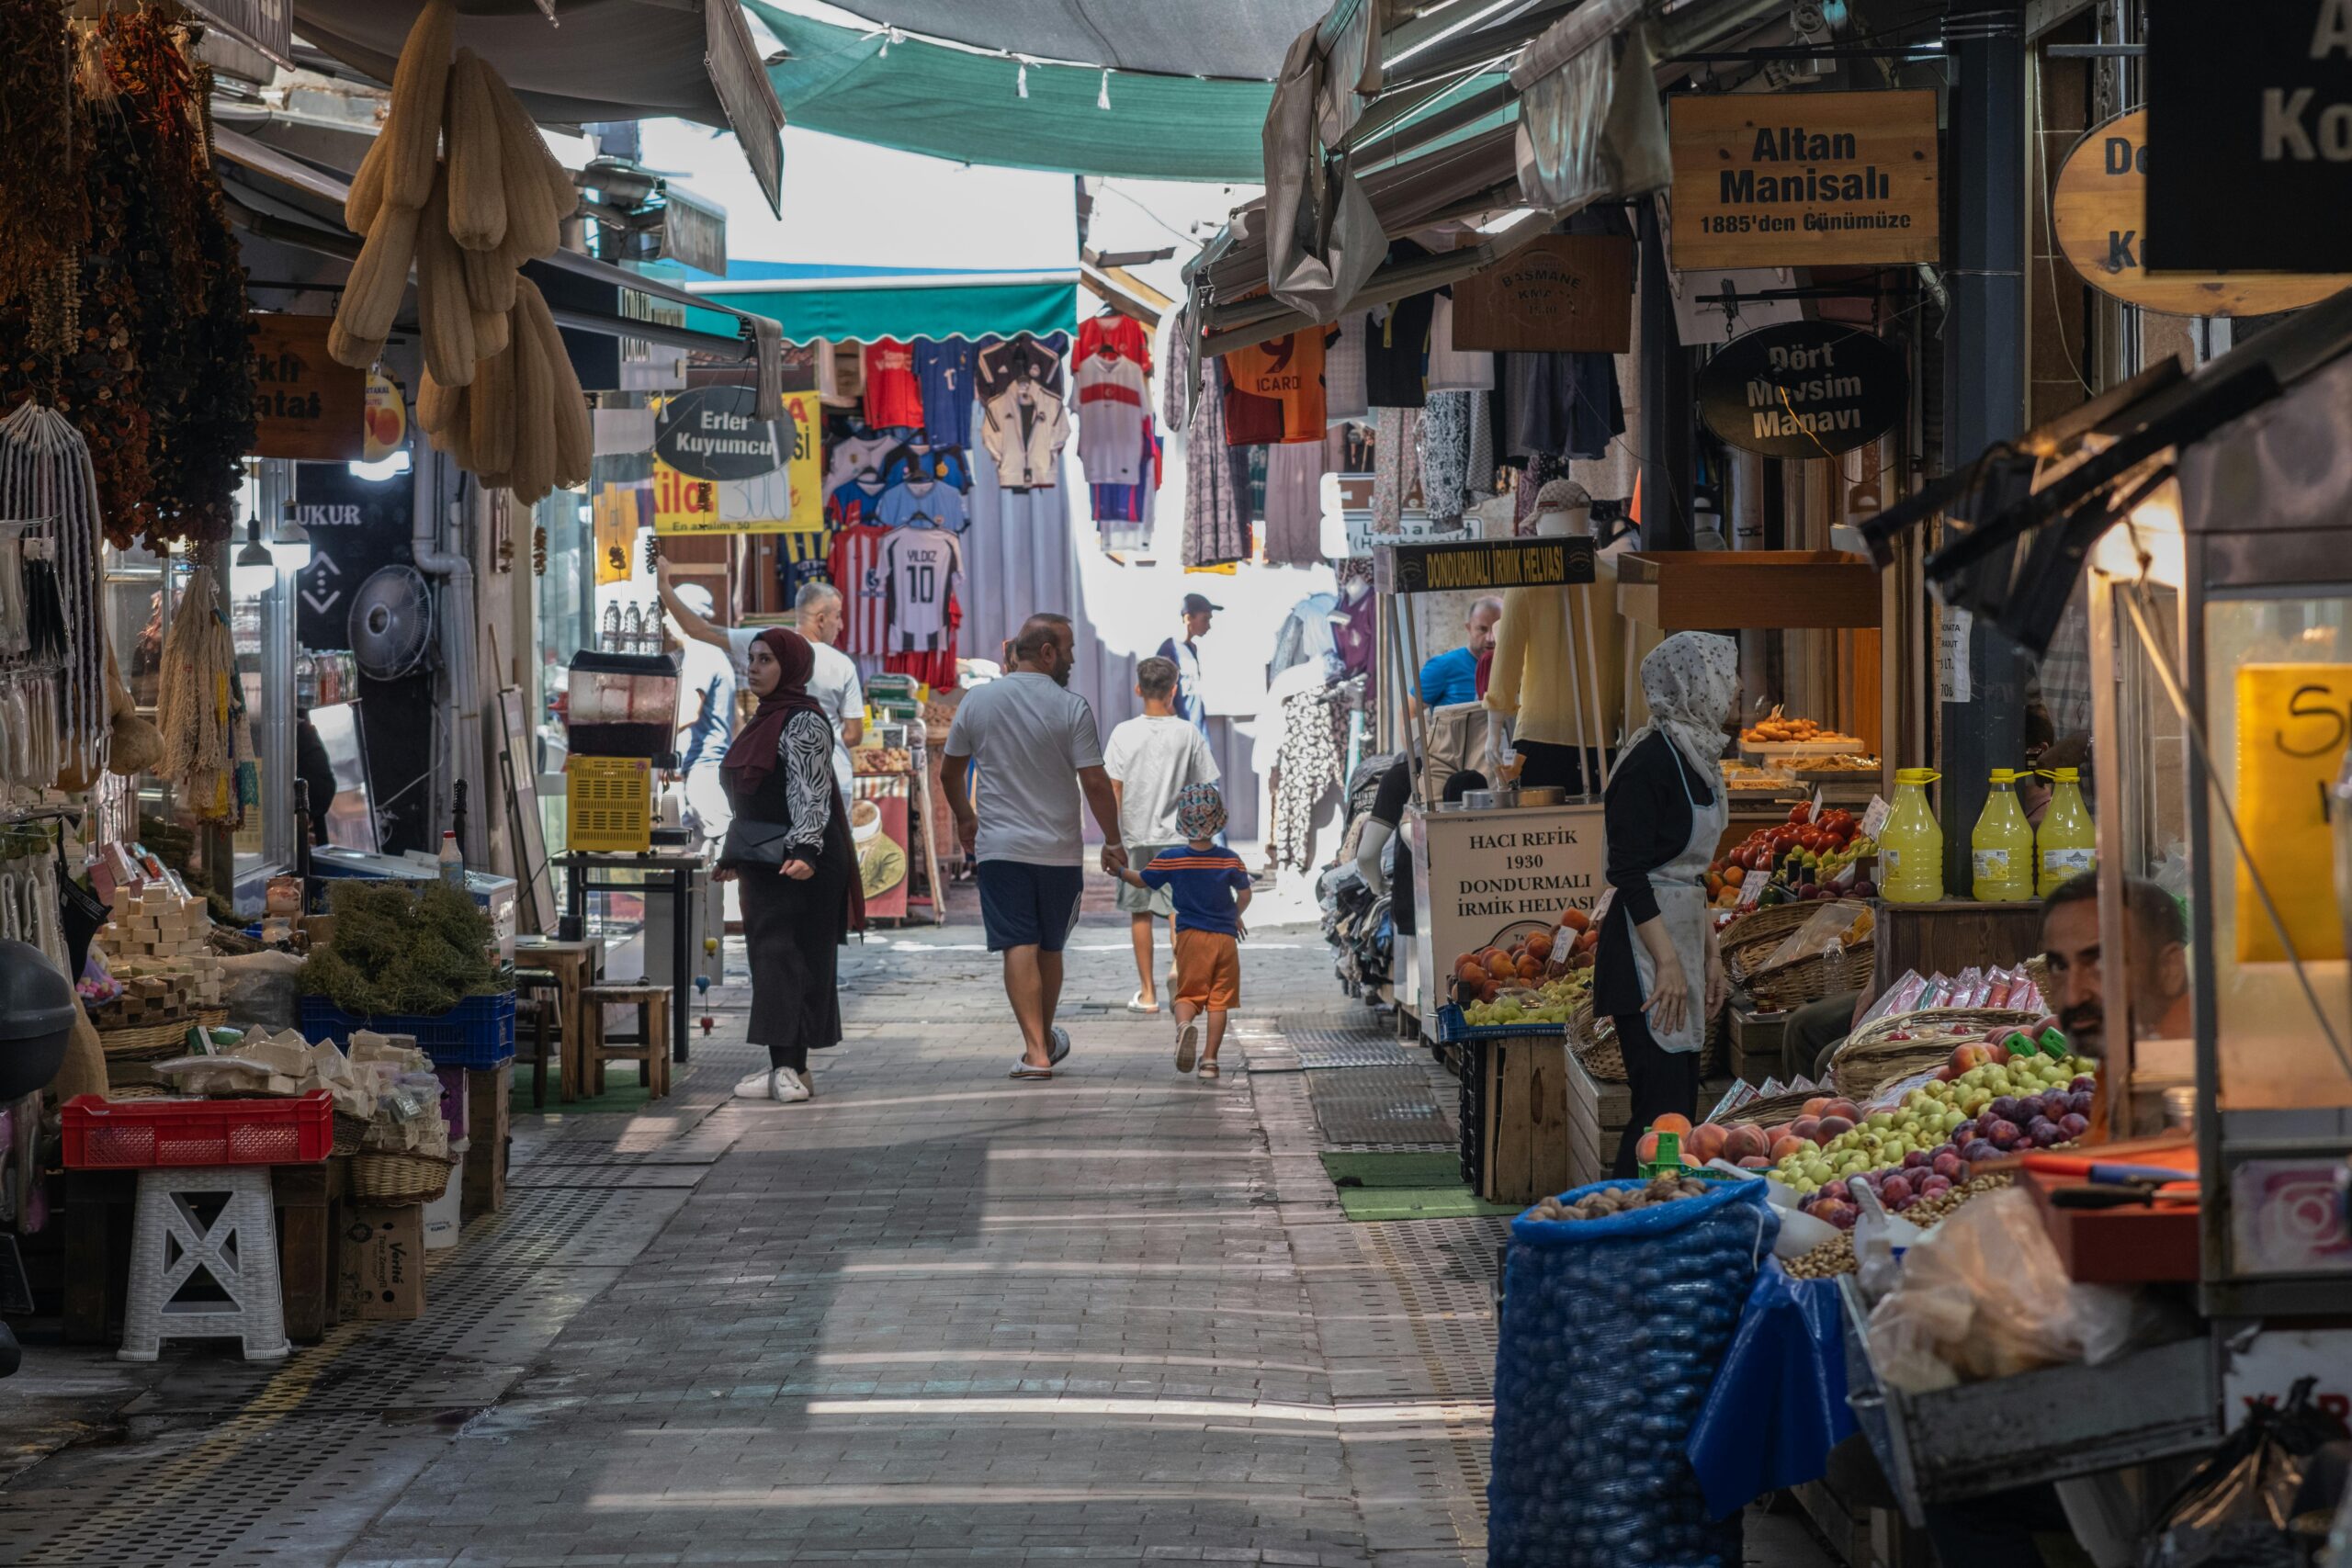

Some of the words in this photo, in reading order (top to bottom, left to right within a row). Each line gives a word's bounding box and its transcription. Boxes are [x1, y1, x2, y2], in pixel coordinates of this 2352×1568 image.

[1752, 127, 1856, 162] Altan
[1720, 166, 1889, 204] Manisalı
[1701, 214, 1795, 233] 1885'den
[1804, 211, 1911, 231] Günümüze
[2109, 231, 2147, 268] K
[1501, 270, 1581, 289] BASMANE
[1769, 342, 1835, 370] Dört
[1747, 373, 1861, 407] Mevsim
[701, 411, 749, 431] Erler
[1753, 409, 1860, 439] Manavı
[676, 433, 773, 457] Kuyumcu
[673, 521, 687, 531] En
[736, 520, 751, 530] 50
[907, 550, 937, 562] YILDIZ
[1426, 551, 1491, 589] DONDURMALI
[1524, 546, 1565, 582] HELVASI
[906, 565, 935, 604] 10
[1470, 833, 1516, 850] HACI
[1521, 826, 1578, 846] REFİK
[1506, 854, 1544, 870] 1930
[1459, 874, 1591, 895] DONDURMALI
[1457, 896, 1514, 917] İRMİK
[1519, 896, 1596, 913] HELVASI
